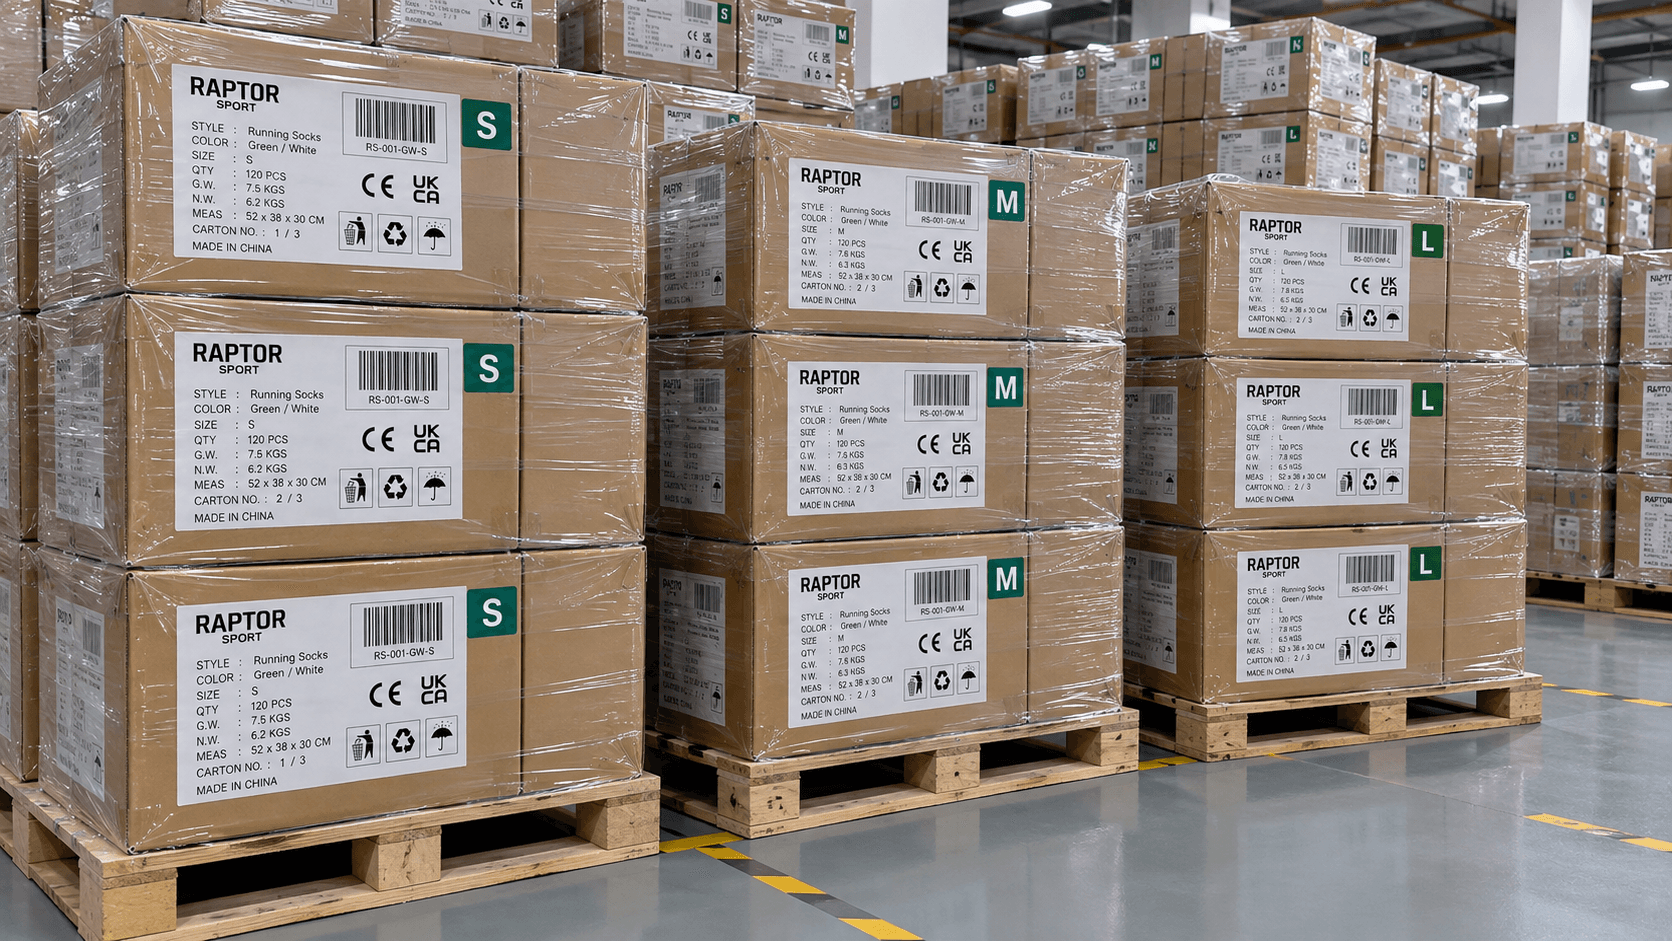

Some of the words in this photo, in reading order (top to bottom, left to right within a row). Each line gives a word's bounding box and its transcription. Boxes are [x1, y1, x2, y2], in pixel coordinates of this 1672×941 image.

[720, 8, 728, 20] S
[838, 29, 846, 41] M
[190, 75, 279, 104] RAPTOR
[216, 99, 257, 112] SPORT
[191, 120, 224, 133] STYLE
[247, 126, 289, 142] Running
[291, 130, 321, 142] Socks
[477, 111, 496, 139] S
[191, 135, 229, 147] COLOR
[248, 139, 278, 152] Green
[288, 143, 317, 155] White
[365, 142, 427, 156] RS-001-GW-S
[191, 150, 215, 161] SIZE
[191, 164, 214, 175] QTY
[245, 169, 263, 180] 120
[265, 170, 287, 182] PCS
[800, 166, 861, 187] RAPTOR
[361, 172, 394, 199] CE
[412, 174, 439, 190] UK
[817, 184, 845, 195] SPORT
[412, 189, 440, 205] CA
[997, 189, 1017, 214] M
[801, 201, 824, 212] STYLE
[840, 205, 869, 217] Running
[870, 207, 891, 216] Socks
[800, 213, 827, 223] COLOR
[840, 216, 862, 225] Green
[868, 218, 888, 227] White
[1249, 217, 1302, 234] RAPTOR
[192, 224, 237, 235] CARTON
[239, 226, 258, 236] NO.
[1264, 232, 1288, 241] SPORT
[192, 241, 223, 252] MADE
[226, 242, 237, 252] IN
[239, 242, 273, 253] CHINA
[953, 239, 972, 253] UK
[1422, 231, 1434, 251] L
[918, 239, 941, 261] CE
[1249, 247, 1269, 256] STYLE
[953, 251, 973, 264] CA
[1282, 258, 1302, 266] Green
[800, 281, 832, 291] CARTON
[1349, 276, 1370, 295] CE
[1380, 276, 1397, 288] UK
[1380, 286, 1398, 297] CA
[193, 342, 282, 363] RAPTOR
[218, 364, 260, 375] SPORT
[480, 354, 499, 383] S
[799, 369, 860, 386] RAPTOR
[816, 386, 844, 395] SPORT
[996, 376, 1016, 399] M
[1246, 384, 1301, 398] RAPTOR
[193, 388, 226, 399] STYLE
[250, 388, 292, 402] Running
[294, 389, 324, 400] Socks
[368, 394, 429, 405] RS-001-GW-S
[1261, 398, 1287, 406] SPORT
[1422, 390, 1434, 410] L
[193, 403, 231, 414] COLOR
[250, 403, 281, 414] Green
[290, 403, 319, 414] White
[799, 404, 823, 414] STYLE
[839, 404, 868, 415] Running
[869, 405, 890, 413] Socks
[194, 419, 217, 430] SIZE
[799, 416, 826, 425] COLOR
[839, 415, 861, 425] Green
[866, 416, 888, 424] White
[1246, 413, 1267, 422] STYLE
[413, 423, 440, 440] UK
[1281, 423, 1301, 431] Green
[194, 435, 216, 445] QTY
[247, 434, 265, 445] 120
[267, 434, 289, 445] PCS
[361, 426, 395, 452] CE
[916, 433, 940, 455] CE
[952, 431, 971, 445] UK
[1380, 437, 1397, 450] UK
[413, 439, 440, 453] CA
[951, 444, 971, 455] CA
[1349, 439, 1370, 458] CE
[1380, 448, 1398, 459] CA
[799, 486, 831, 495] CARTON
[194, 495, 239, 506] CARTON
[241, 494, 260, 504] NO.
[194, 512, 225, 523] MADE
[228, 512, 239, 522] IN
[241, 511, 274, 521] CHINA
[1247, 555, 1300, 572] RAPTOR
[1420, 554, 1432, 574] L
[997, 567, 1017, 591] M
[1261, 570, 1286, 579] SPORT
[800, 573, 861, 593] RAPTOR
[817, 590, 845, 601] SPORT
[1247, 586, 1267, 595] STYLE
[1281, 595, 1300, 603] Green
[483, 598, 502, 627] S
[800, 611, 824, 625] STYLE
[839, 610, 869, 619] Running
[870, 607, 891, 617] Socks
[1347, 607, 1368, 626] CE
[1378, 603, 1395, 616] UK
[195, 608, 286, 634] RAPTOR
[800, 623, 827, 634] COLOR
[840, 621, 862, 630] Green
[867, 618, 888, 627] White
[1377, 614, 1395, 625] CA
[221, 631, 262, 644] SPORT
[953, 626, 972, 641] UK
[918, 631, 941, 654] CE
[953, 639, 972, 652] CA
[373, 646, 435, 660] RS-001-GW-S
[196, 657, 230, 671] STYLE
[253, 653, 295, 665] Running
[298, 650, 328, 662] Socks
[196, 672, 234, 686] COLOR
[253, 669, 285, 680] Green
[294, 664, 324, 676] White
[420, 673, 447, 690] UK
[196, 689, 220, 701] SIZE
[369, 680, 402, 708] CE
[420, 688, 447, 705] CA
[800, 694, 832, 706] CARTON
[196, 704, 219, 717] QTY
[250, 700, 268, 711] 120
[271, 697, 292, 709] PCS
[196, 763, 242, 778] CARTON
[244, 761, 262, 772] NO.
[196, 782, 228, 796] MADE
[231, 780, 241, 791] IN
[244, 776, 278, 790] CHINA
